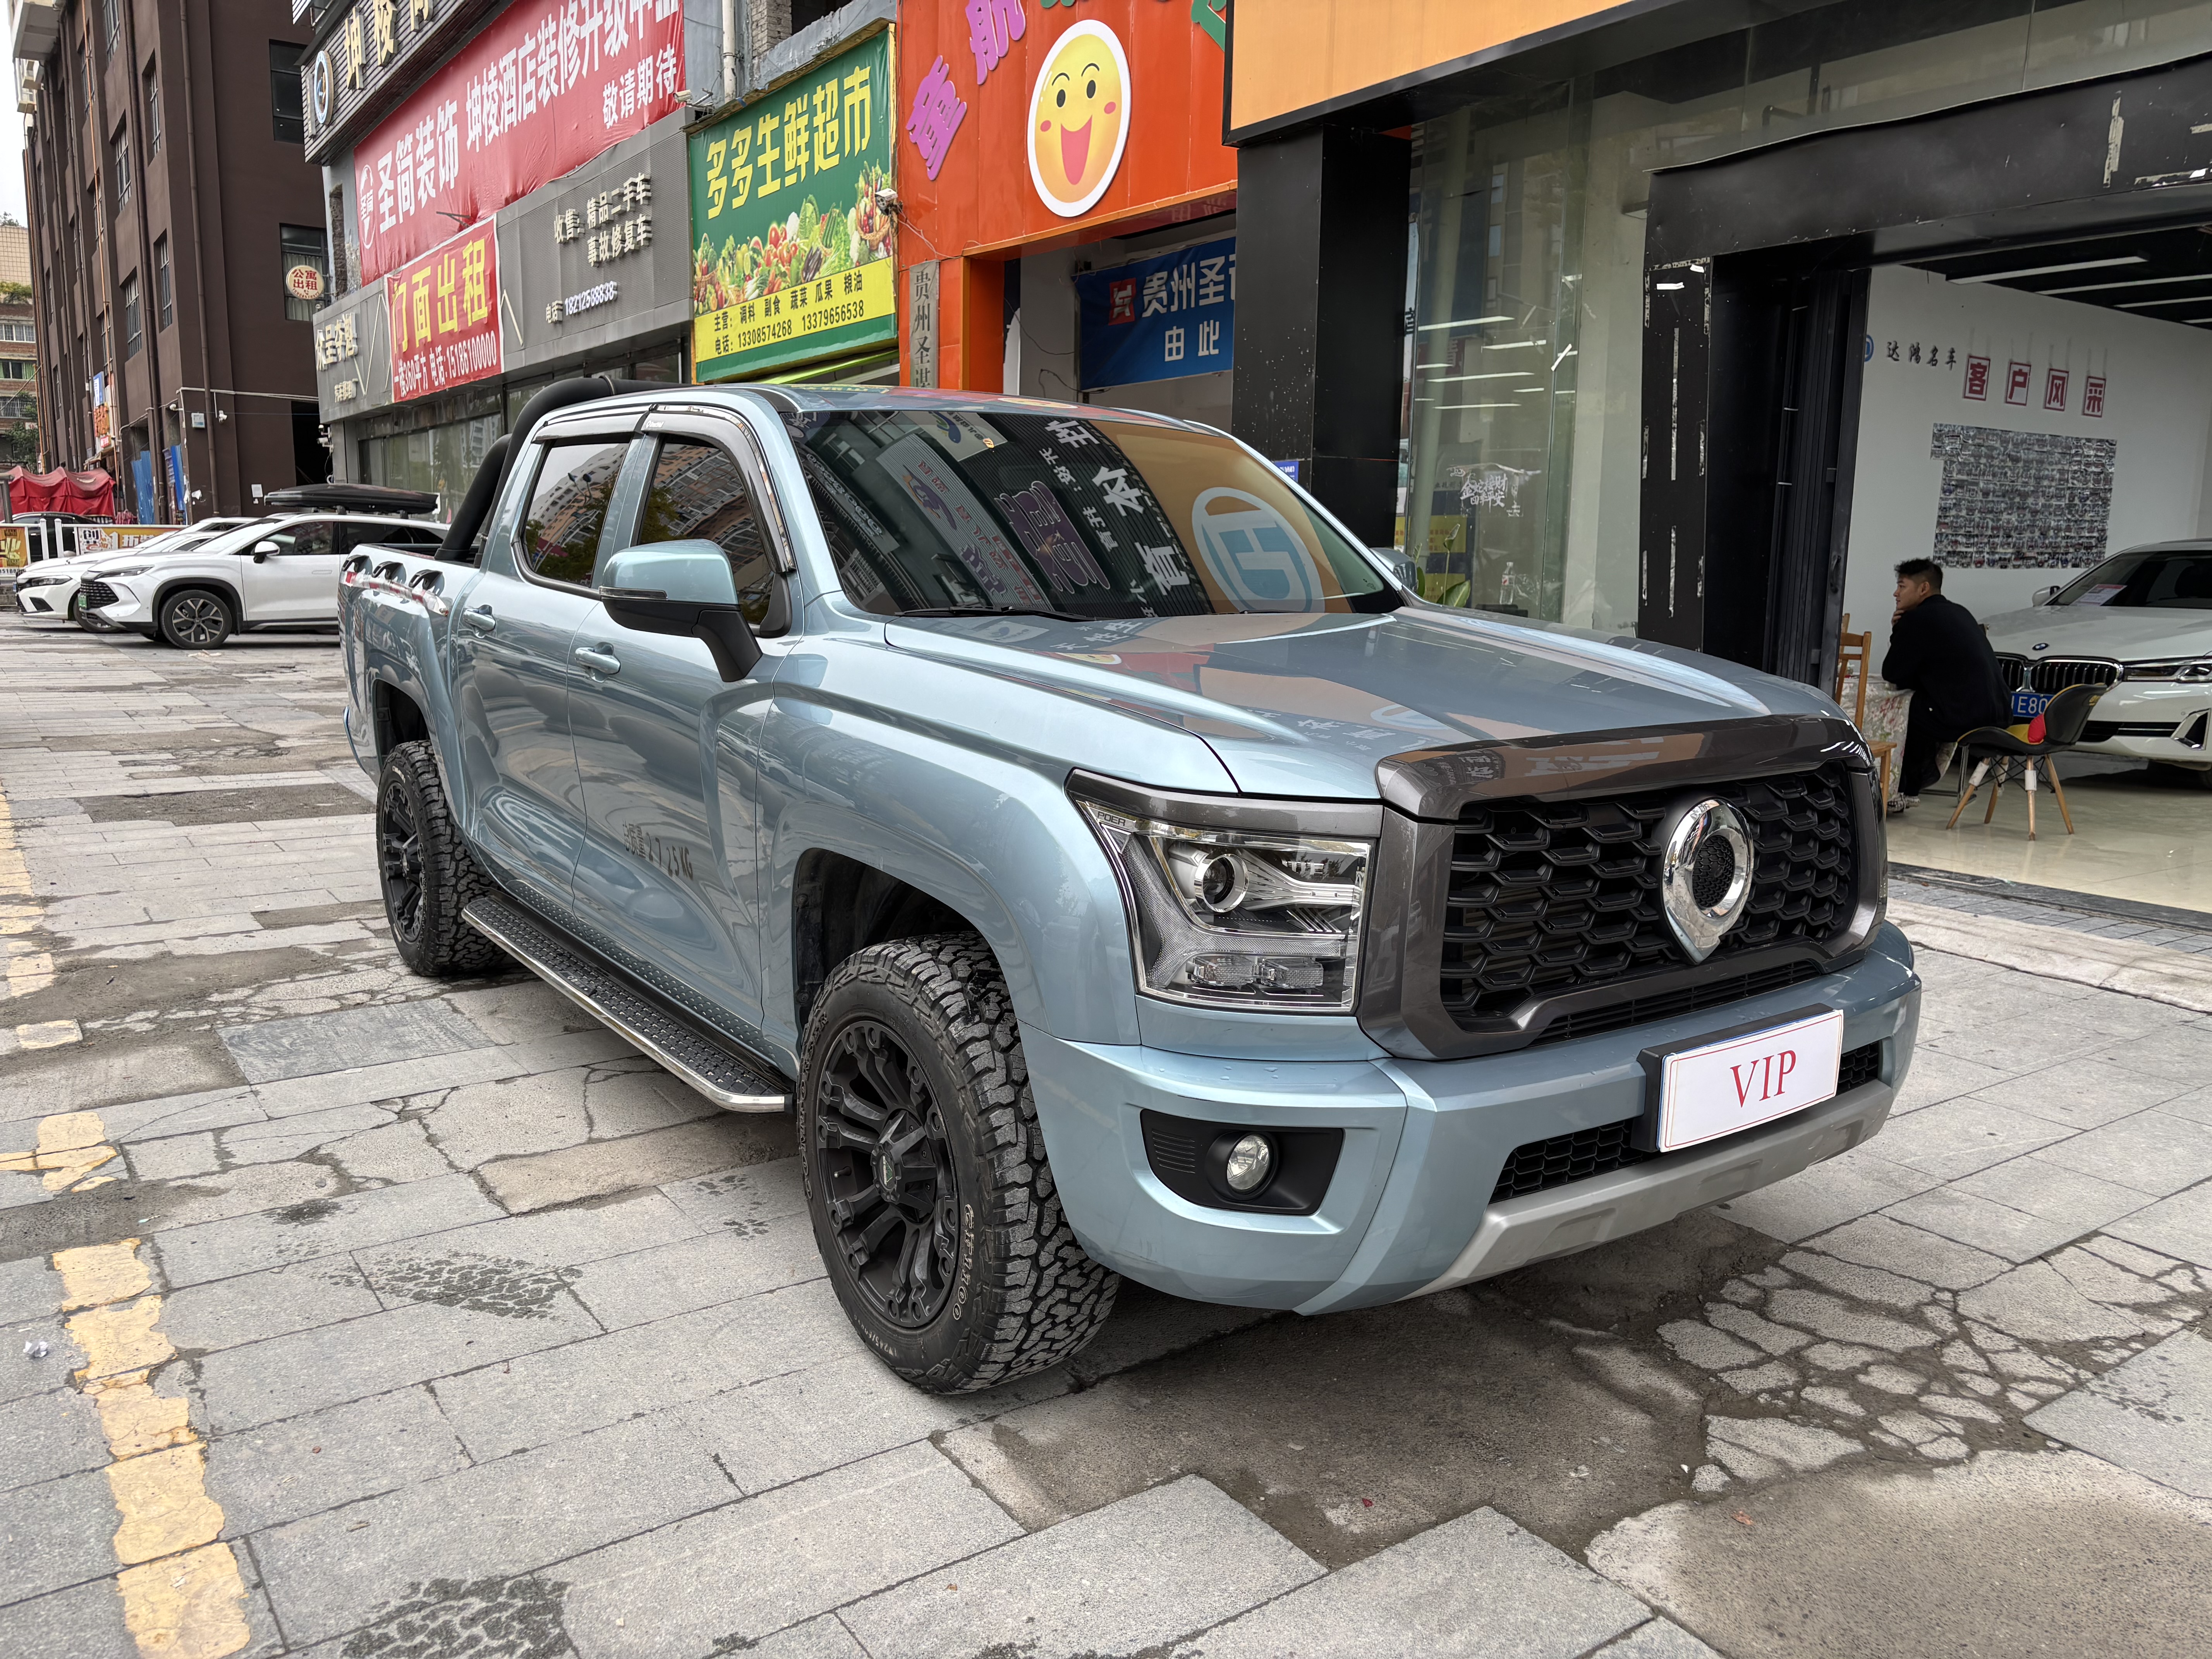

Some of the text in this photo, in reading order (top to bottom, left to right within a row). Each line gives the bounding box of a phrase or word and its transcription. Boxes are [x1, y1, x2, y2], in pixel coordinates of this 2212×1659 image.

[603, 43, 677, 129] 敬请期待
[378, 99, 459, 234] 圣简装饰
[707, 66, 871, 220] 多多生鲜超市
[587, 173, 651, 229] 精品二手车
[587, 214, 652, 267] 事故修复车
[292, 269, 317, 280] 公寓
[293, 279, 318, 290] 出租
[392, 239, 488, 353] 门面出租
[565, 281, 617, 316] 18212588838
[740, 302, 755, 324] 调料
[765, 295, 780, 316] 副食
[790, 287, 807, 310] 蔬菜
[815, 279, 833, 303] 瓜果
[844, 270, 862, 295] 粮油
[738, 319, 792, 348] 13308574268
[802, 300, 864, 331] 13379656538
[1165, 320, 1219, 362] 由此
[2011, 696, 2048, 714] E80
[1097, 811, 1127, 827] POER
[1729, 1050, 1796, 1108] VIP
[953, 1204, 975, 1320] CF1100
